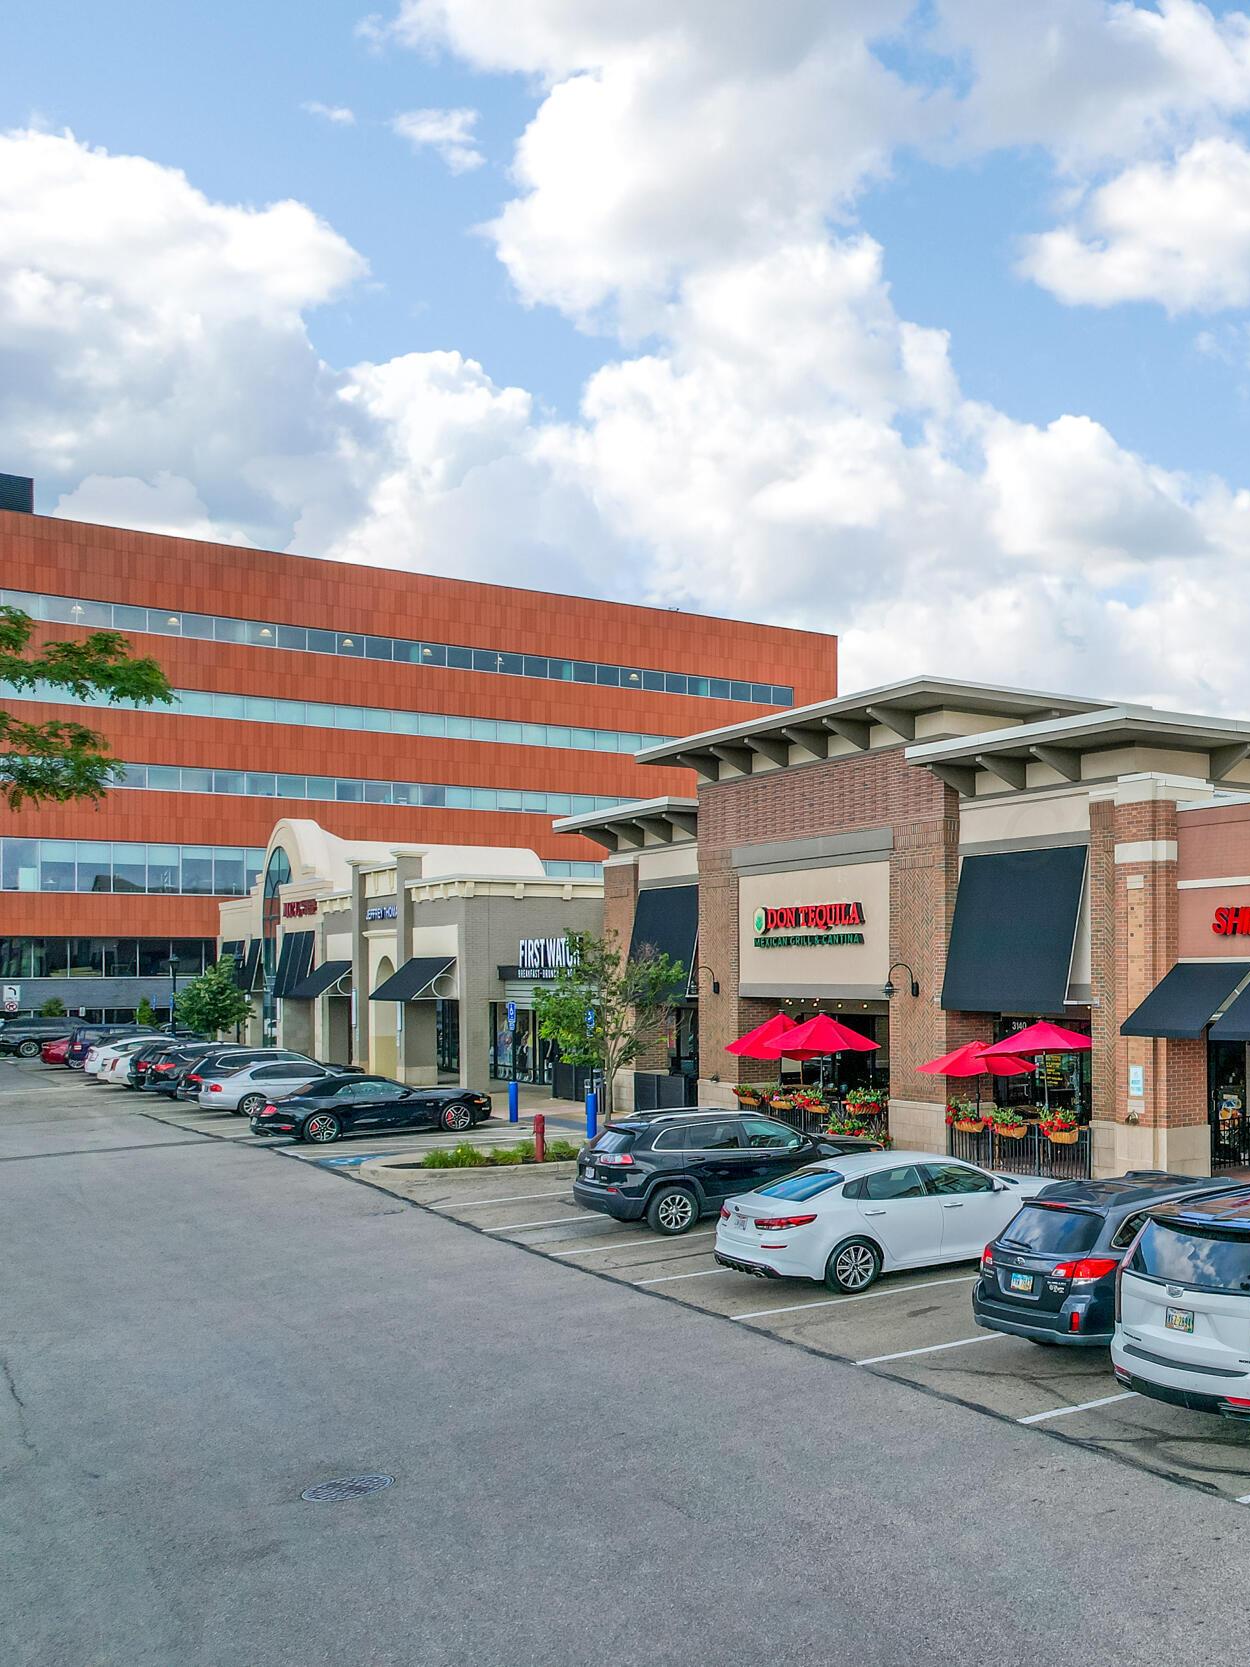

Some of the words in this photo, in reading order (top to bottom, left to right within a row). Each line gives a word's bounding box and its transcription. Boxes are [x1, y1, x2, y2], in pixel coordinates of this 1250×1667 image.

[767, 907, 797, 929] DON
[798, 902, 862, 930] TEQUILA
[519, 939, 545, 969] FIRST
[754, 937, 788, 948] MEXICAN
[789, 936, 813, 946] GRILL
[822, 933, 861, 945] CANTINA
